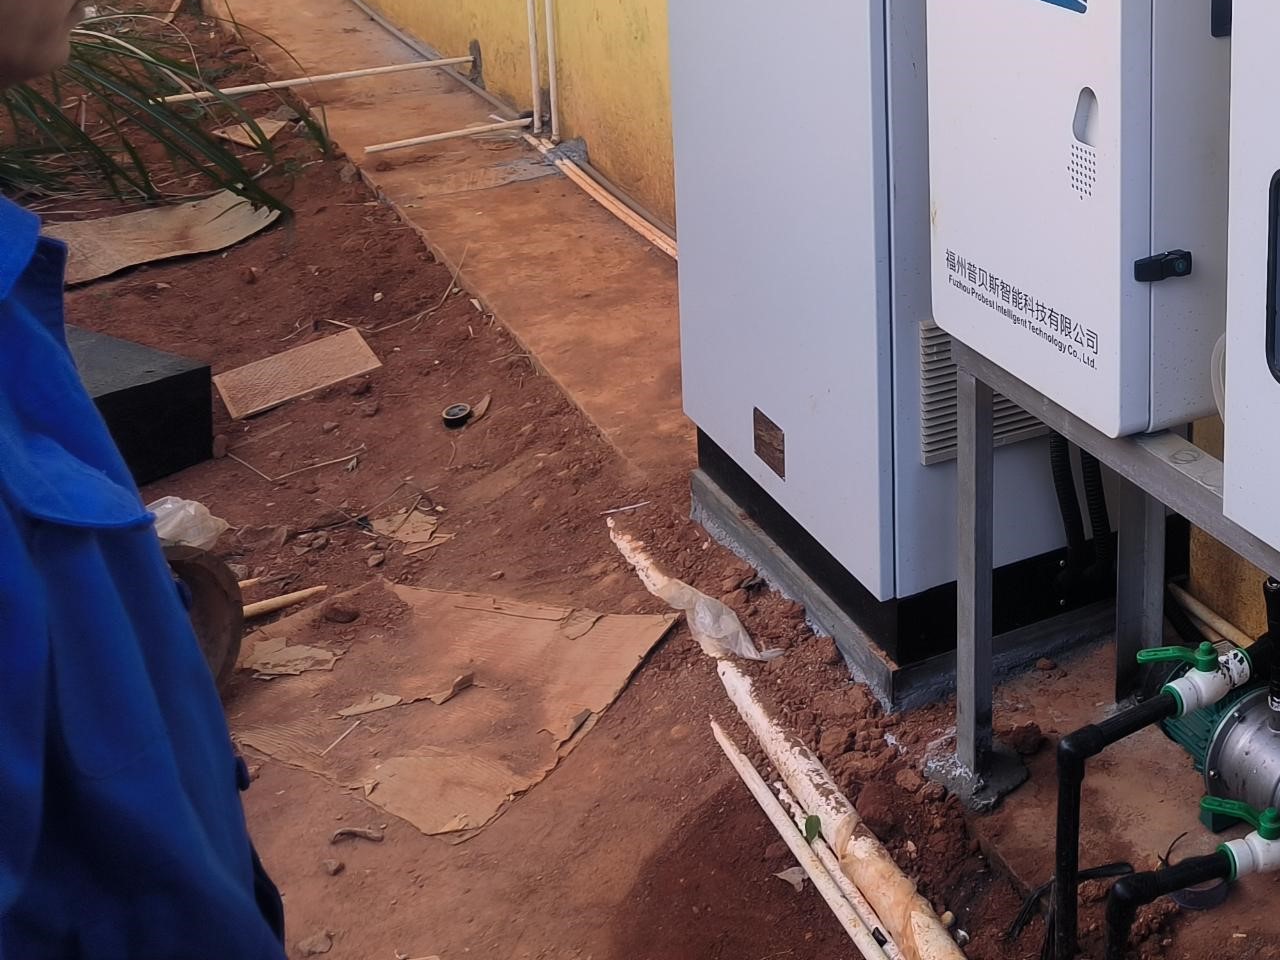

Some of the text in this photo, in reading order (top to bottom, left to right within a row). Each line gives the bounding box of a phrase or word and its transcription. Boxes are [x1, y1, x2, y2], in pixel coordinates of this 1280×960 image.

[945, 249, 1099, 355] 福州普贝斯智能科技有限公司
[948, 274, 971, 295] Fuzhou
[971, 287, 995, 309] Probest
[995, 300, 1027, 329] Intelligent
[1028, 321, 1067, 354] Technology
[1082, 352, 1098, 371] Ltd.
